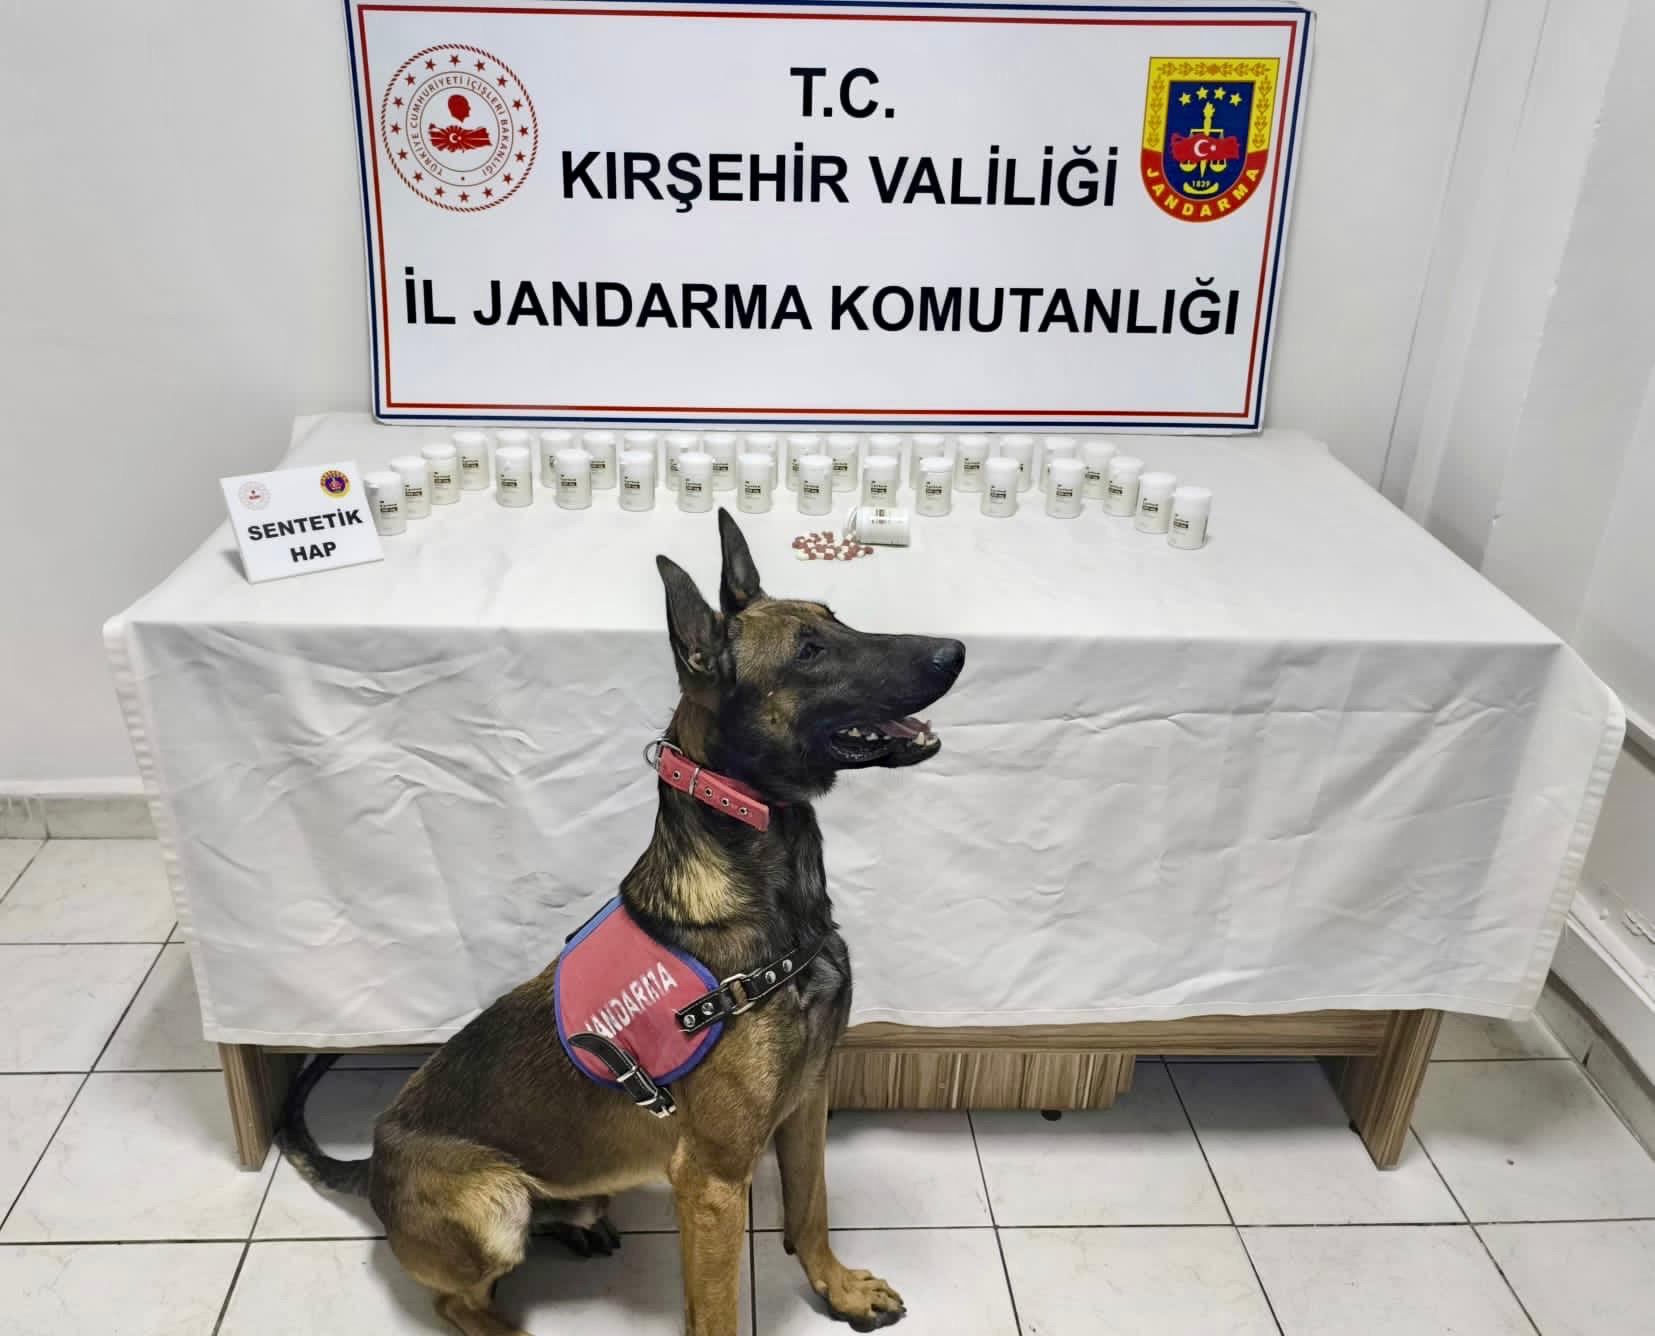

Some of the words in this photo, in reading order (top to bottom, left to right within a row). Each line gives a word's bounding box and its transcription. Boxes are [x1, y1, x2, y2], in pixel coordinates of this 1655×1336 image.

[410, 76, 463, 129] CUMHURİYETİ
[466, 77, 503, 116] İÇİŞLERİ
[789, 67, 895, 119] T.C.
[410, 133, 443, 177] TÜRKİYE
[482, 119, 510, 177] BAKANLIĞI
[561, 141, 849, 214] KIRŞEHİR
[868, 144, 1118, 207] VALİLİĞİ
[1146, 167, 1260, 217] JANDARMA
[404, 266, 456, 325] İL
[473, 279, 813, 330] JANDARMA
[831, 276, 1240, 336] KOMUTANLIĞI
[248, 508, 363, 541] SENTETİK
[290, 541, 336, 563] HAP
